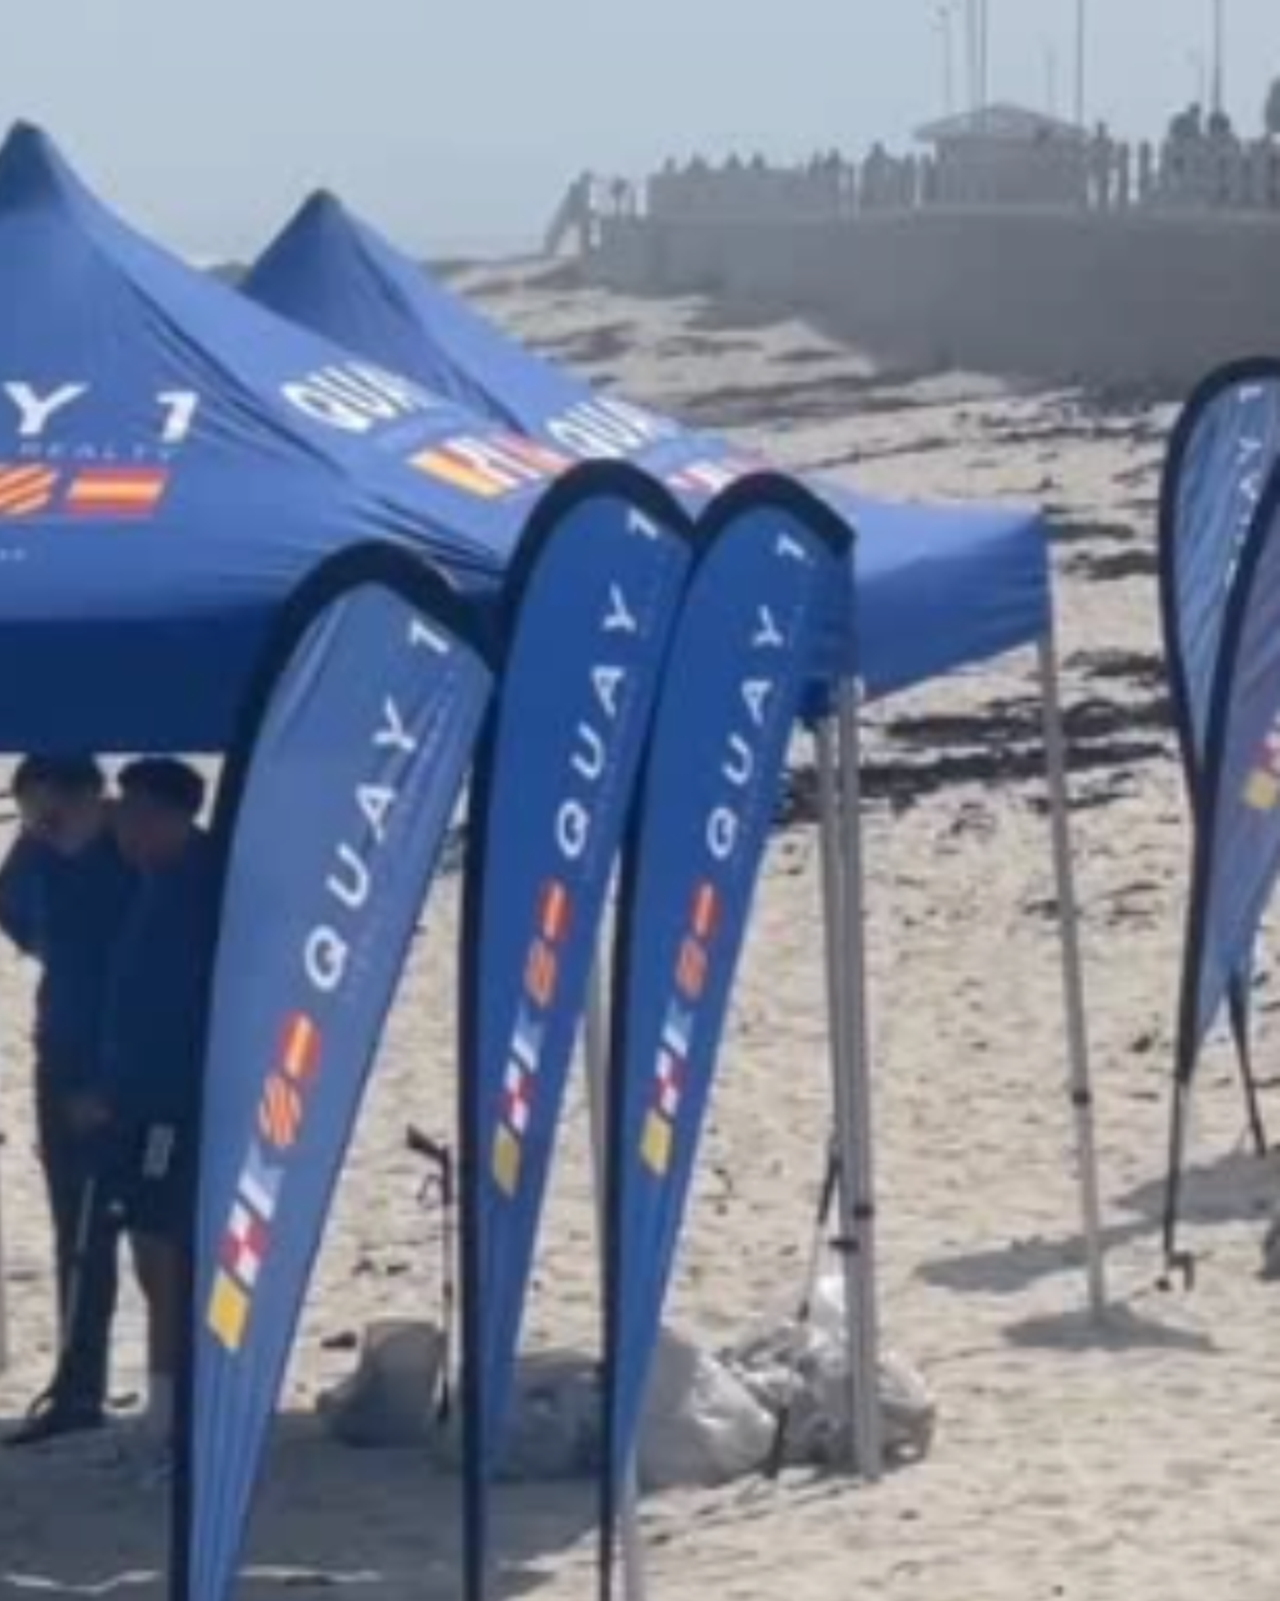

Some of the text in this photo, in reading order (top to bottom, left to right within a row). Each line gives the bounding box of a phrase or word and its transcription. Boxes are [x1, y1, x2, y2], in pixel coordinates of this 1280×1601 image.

[155, 391, 200, 444] 1
[278, 361, 428, 435] QUA
[546, 396, 660, 459] QUA
[556, 580, 638, 860] QUAY
[625, 506, 659, 540] 1
[706, 603, 785, 861] QUAY
[775, 532, 810, 562] 1
[303, 695, 418, 993] QUAY
[408, 618, 449, 655] 1
